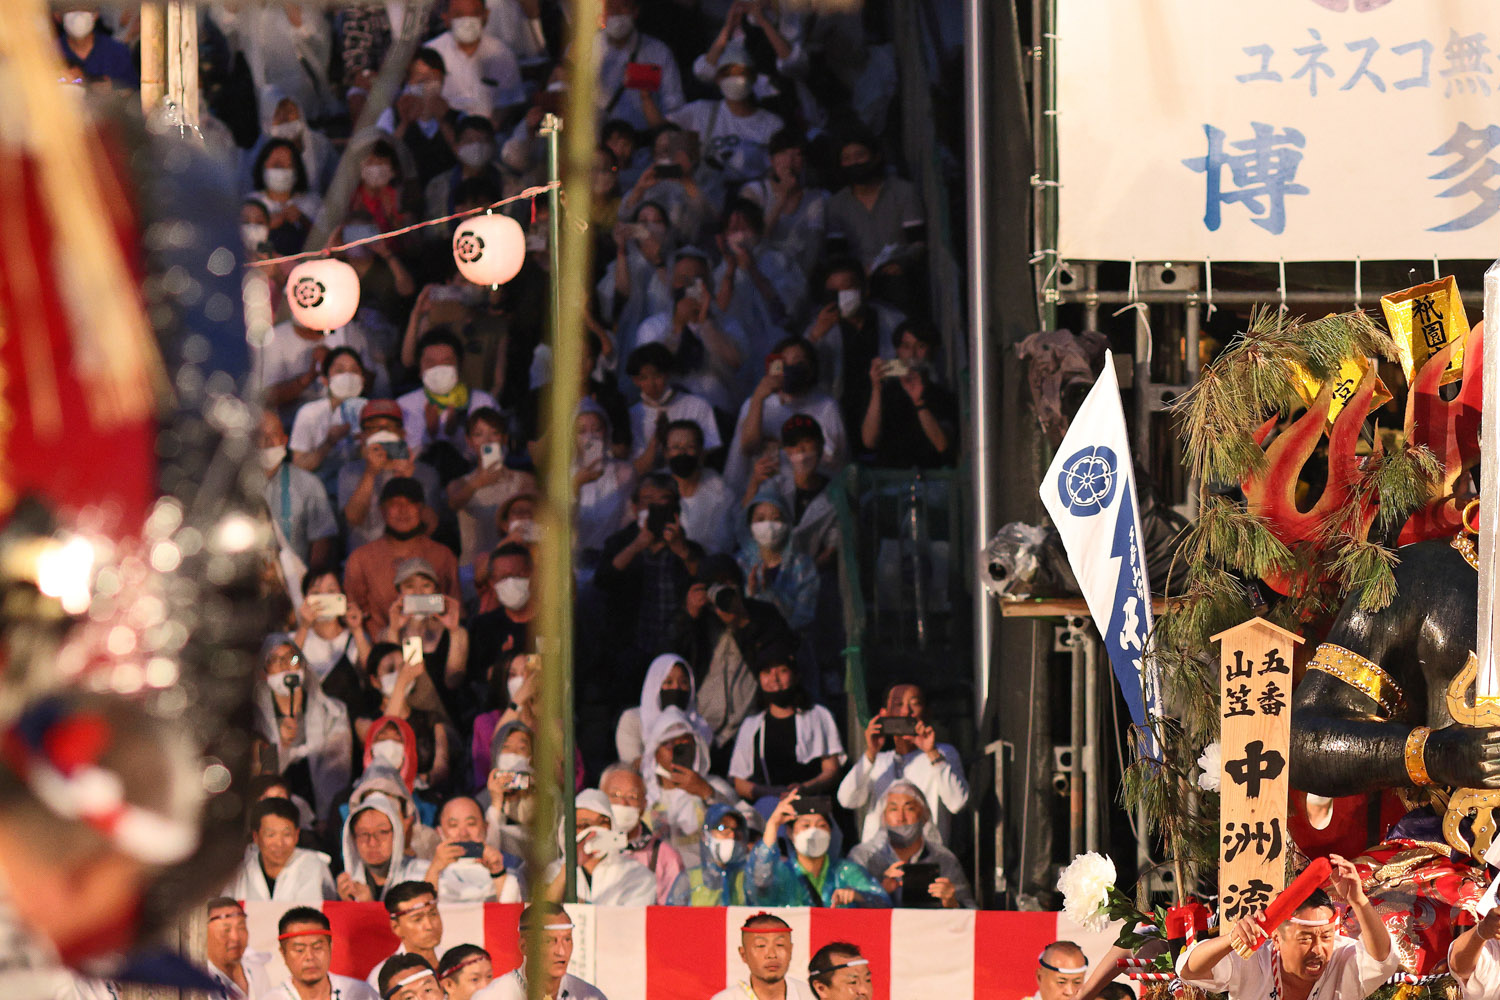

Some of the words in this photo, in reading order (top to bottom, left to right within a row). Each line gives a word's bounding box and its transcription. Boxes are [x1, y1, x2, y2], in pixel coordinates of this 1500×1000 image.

[1223, 650, 1255, 718] 山笠
[1257, 649, 1290, 716] 五番
[1223, 740, 1286, 923] 中洲流
